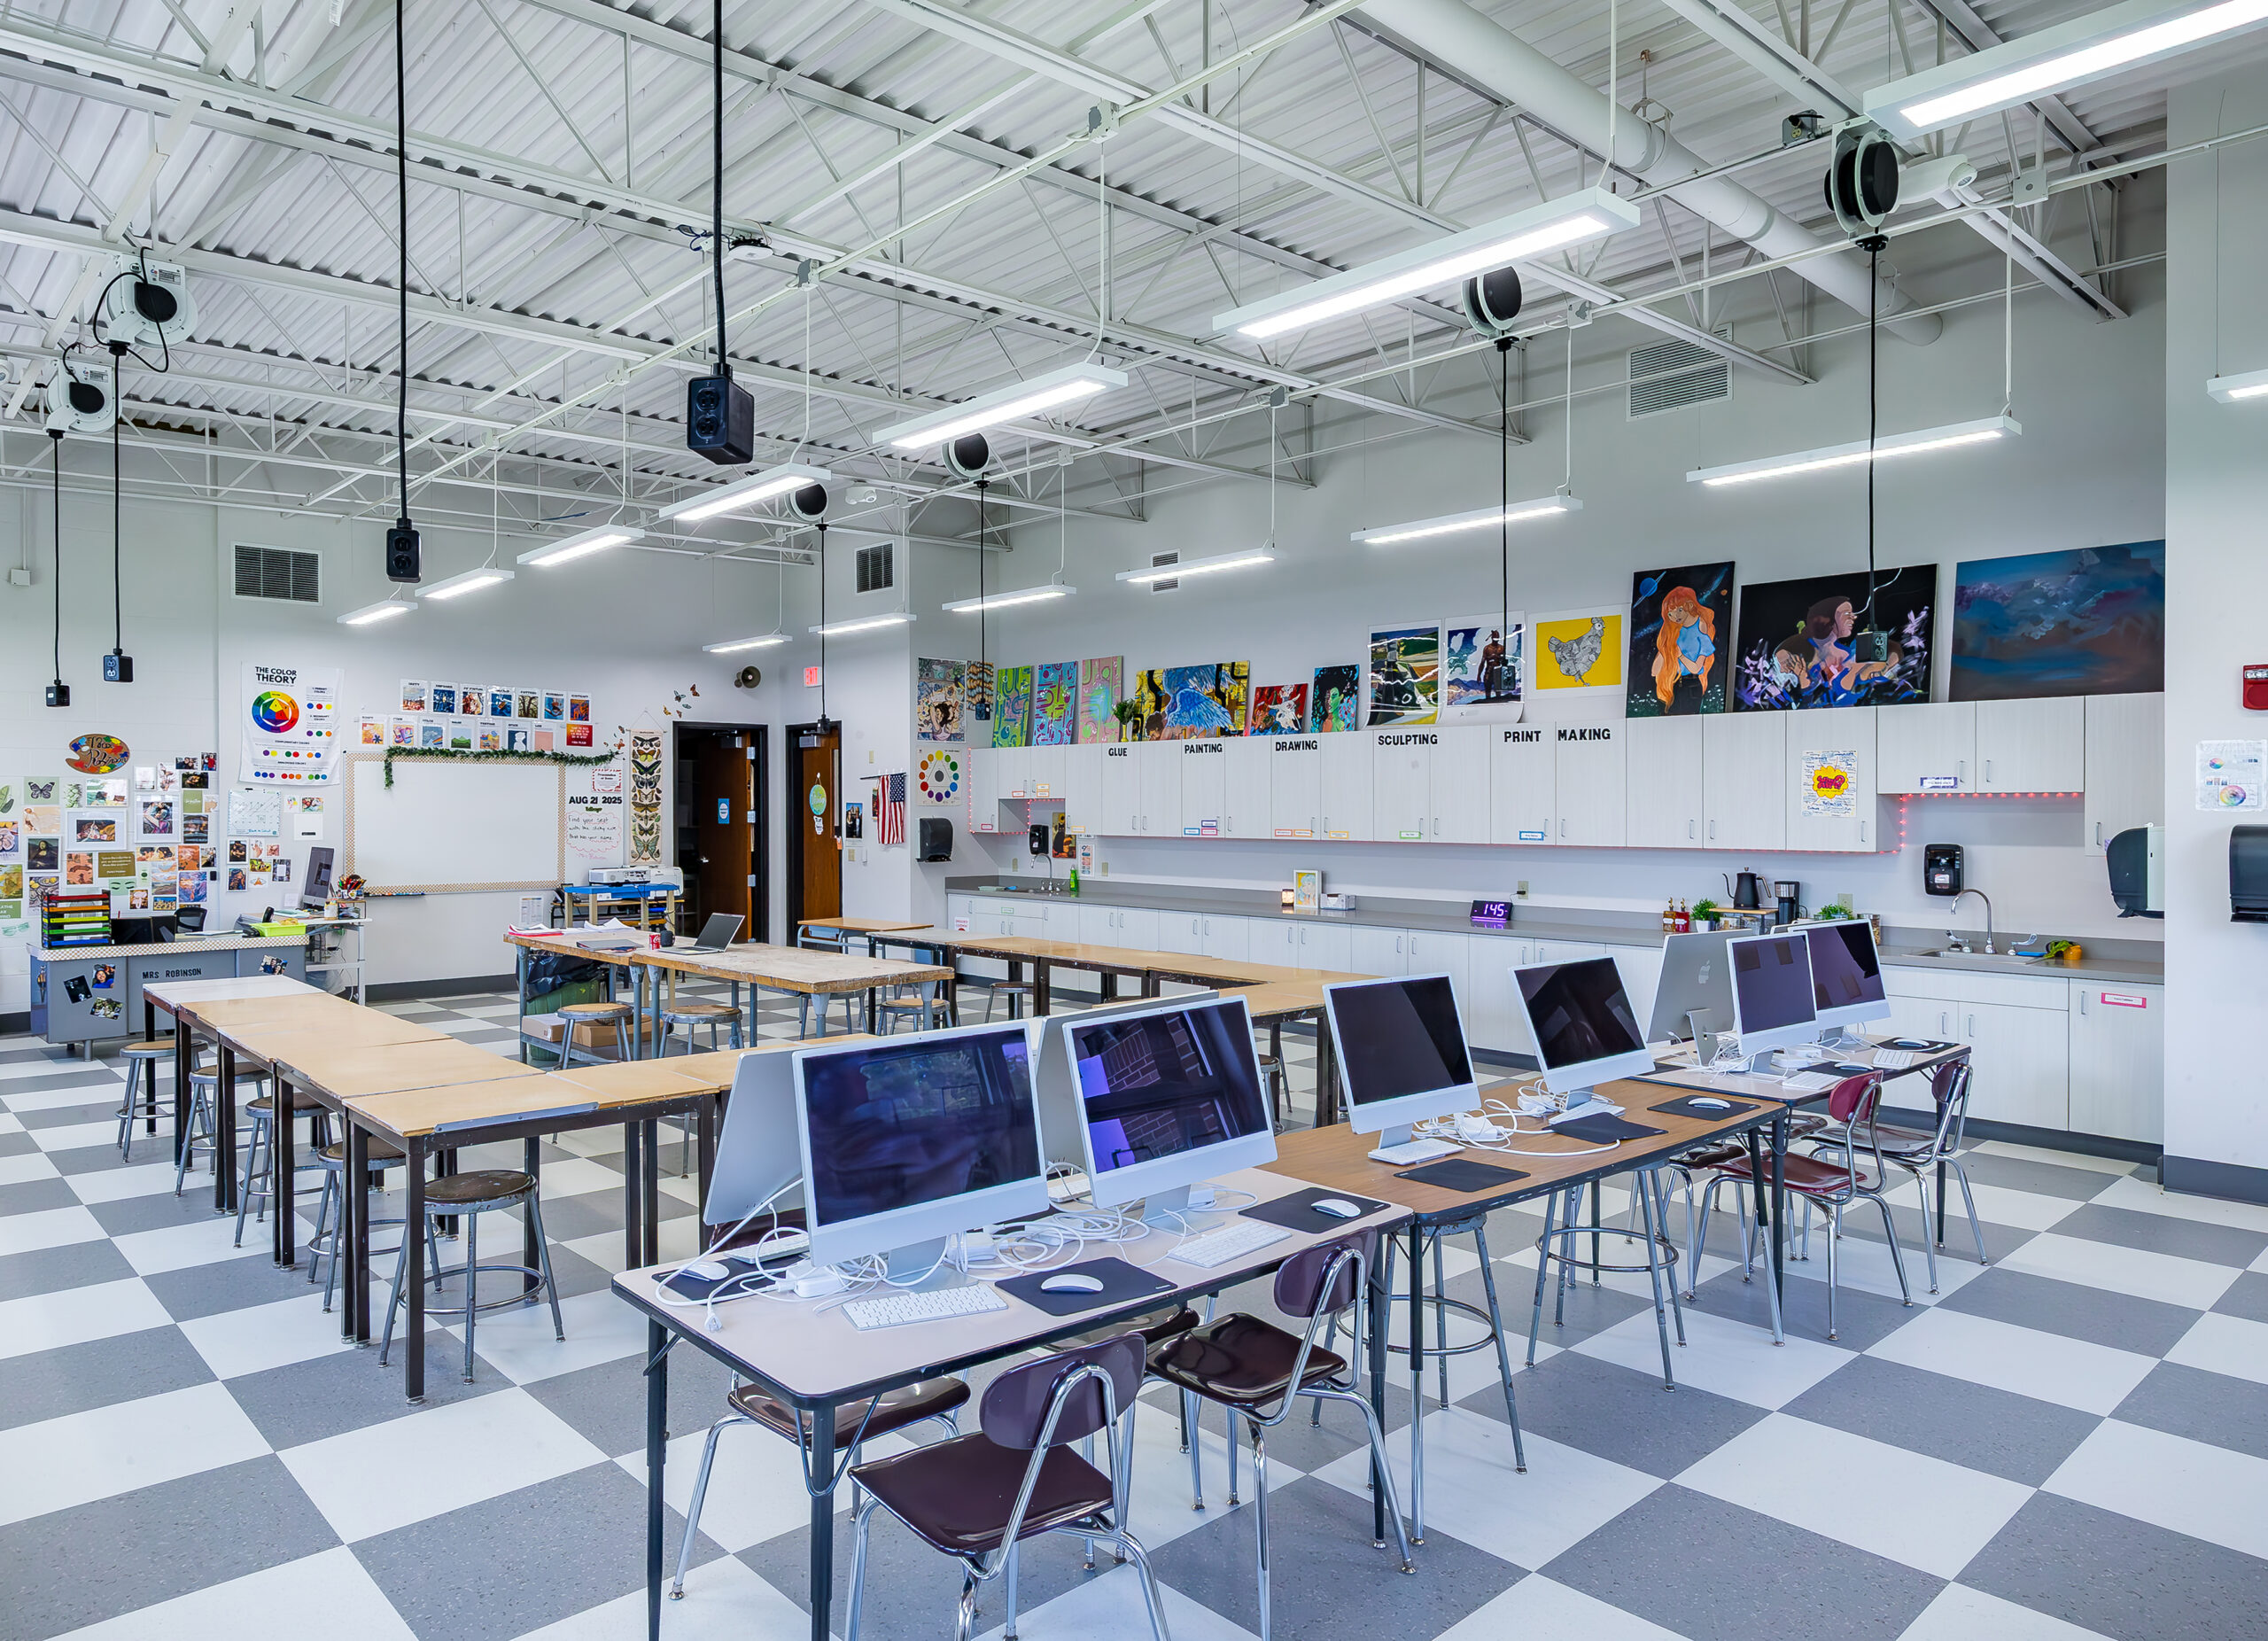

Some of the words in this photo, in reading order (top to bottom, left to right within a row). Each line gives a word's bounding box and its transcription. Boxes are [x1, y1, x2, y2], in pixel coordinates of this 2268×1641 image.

[256, 673, 297, 684] THEORY
[804, 667, 819, 685] EXIT
[1378, 735, 1438, 745] SCULPTING
[1503, 730, 1542, 743] PRINT
[1557, 728, 1611, 741] MAKING
[1184, 743, 1223, 754] PAINTING
[1275, 740, 1318, 751] DRAWING
[1108, 748, 1128, 757] GLUE
[165, 968, 202, 978] ROBINSON
